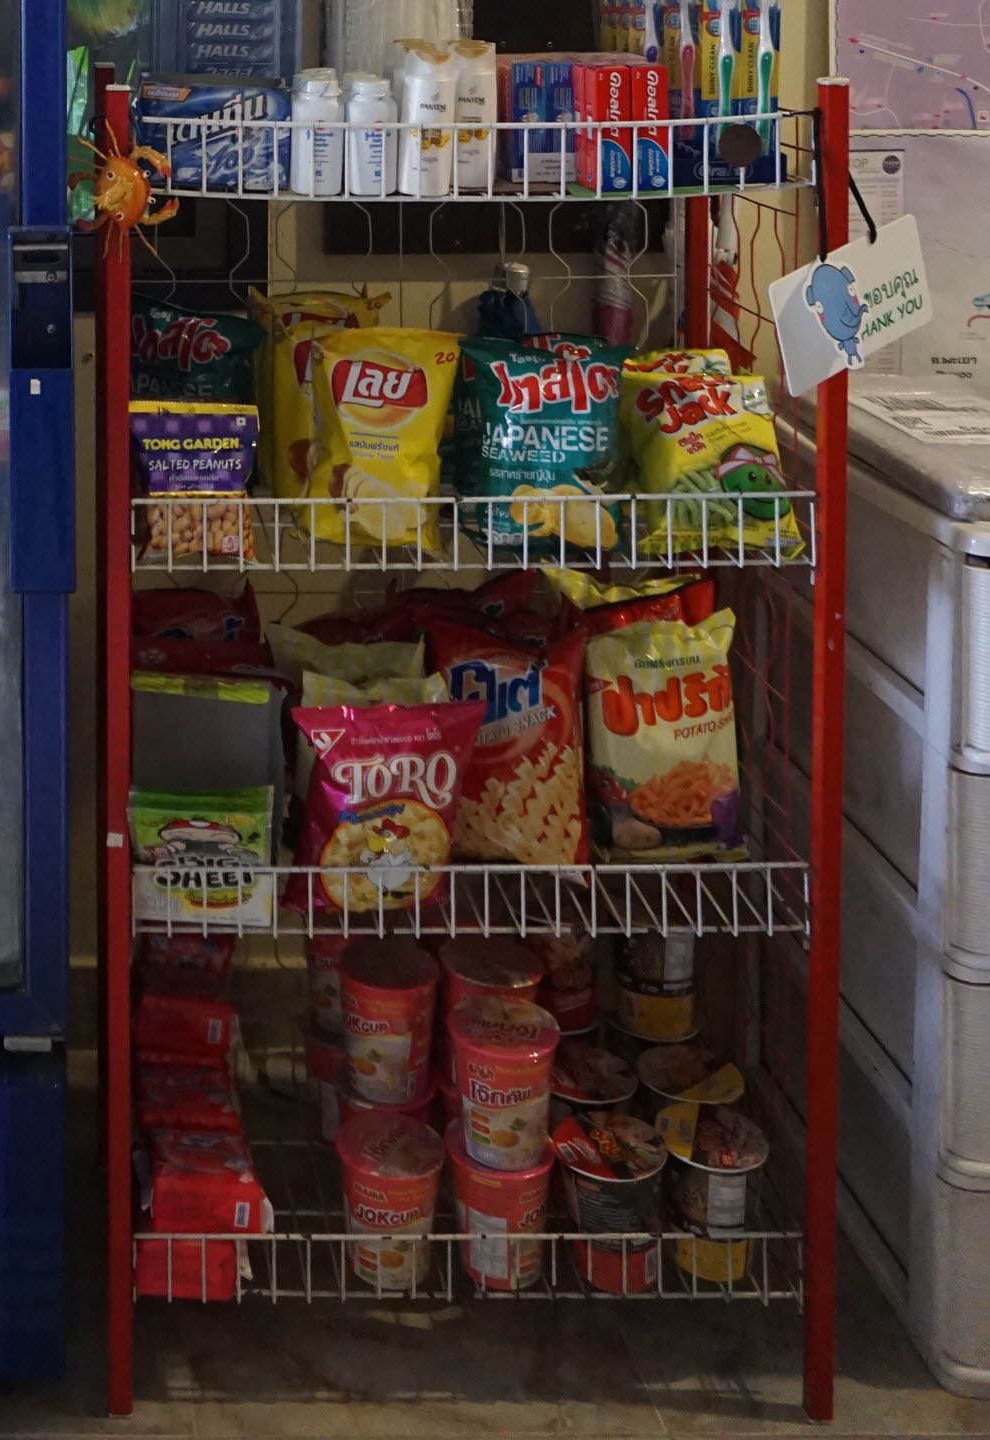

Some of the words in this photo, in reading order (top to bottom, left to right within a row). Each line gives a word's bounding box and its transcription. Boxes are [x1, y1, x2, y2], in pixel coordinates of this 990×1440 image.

[197, 1, 250, 15] HALLS
[195, 24, 250, 37] HALLS
[195, 44, 250, 58] HALLS
[419, 103, 447, 113] PANTENE
[458, 96, 486, 106] PANTENE
[864, 269, 919, 308] ขอบคุณ
[861, 311, 894, 341] HANK
[897, 295, 923, 319] YOU
[659, 385, 738, 434] Jack
[142, 438, 181, 451] TONG
[182, 437, 240, 451] GARDEN
[481, 445, 566, 464] SEAWEED
[148, 459, 190, 471] SALTED
[193, 459, 242, 471] PEANUTS
[673, 721, 716, 741] POTATO
[345, 1013, 389, 1034] OKCUP
